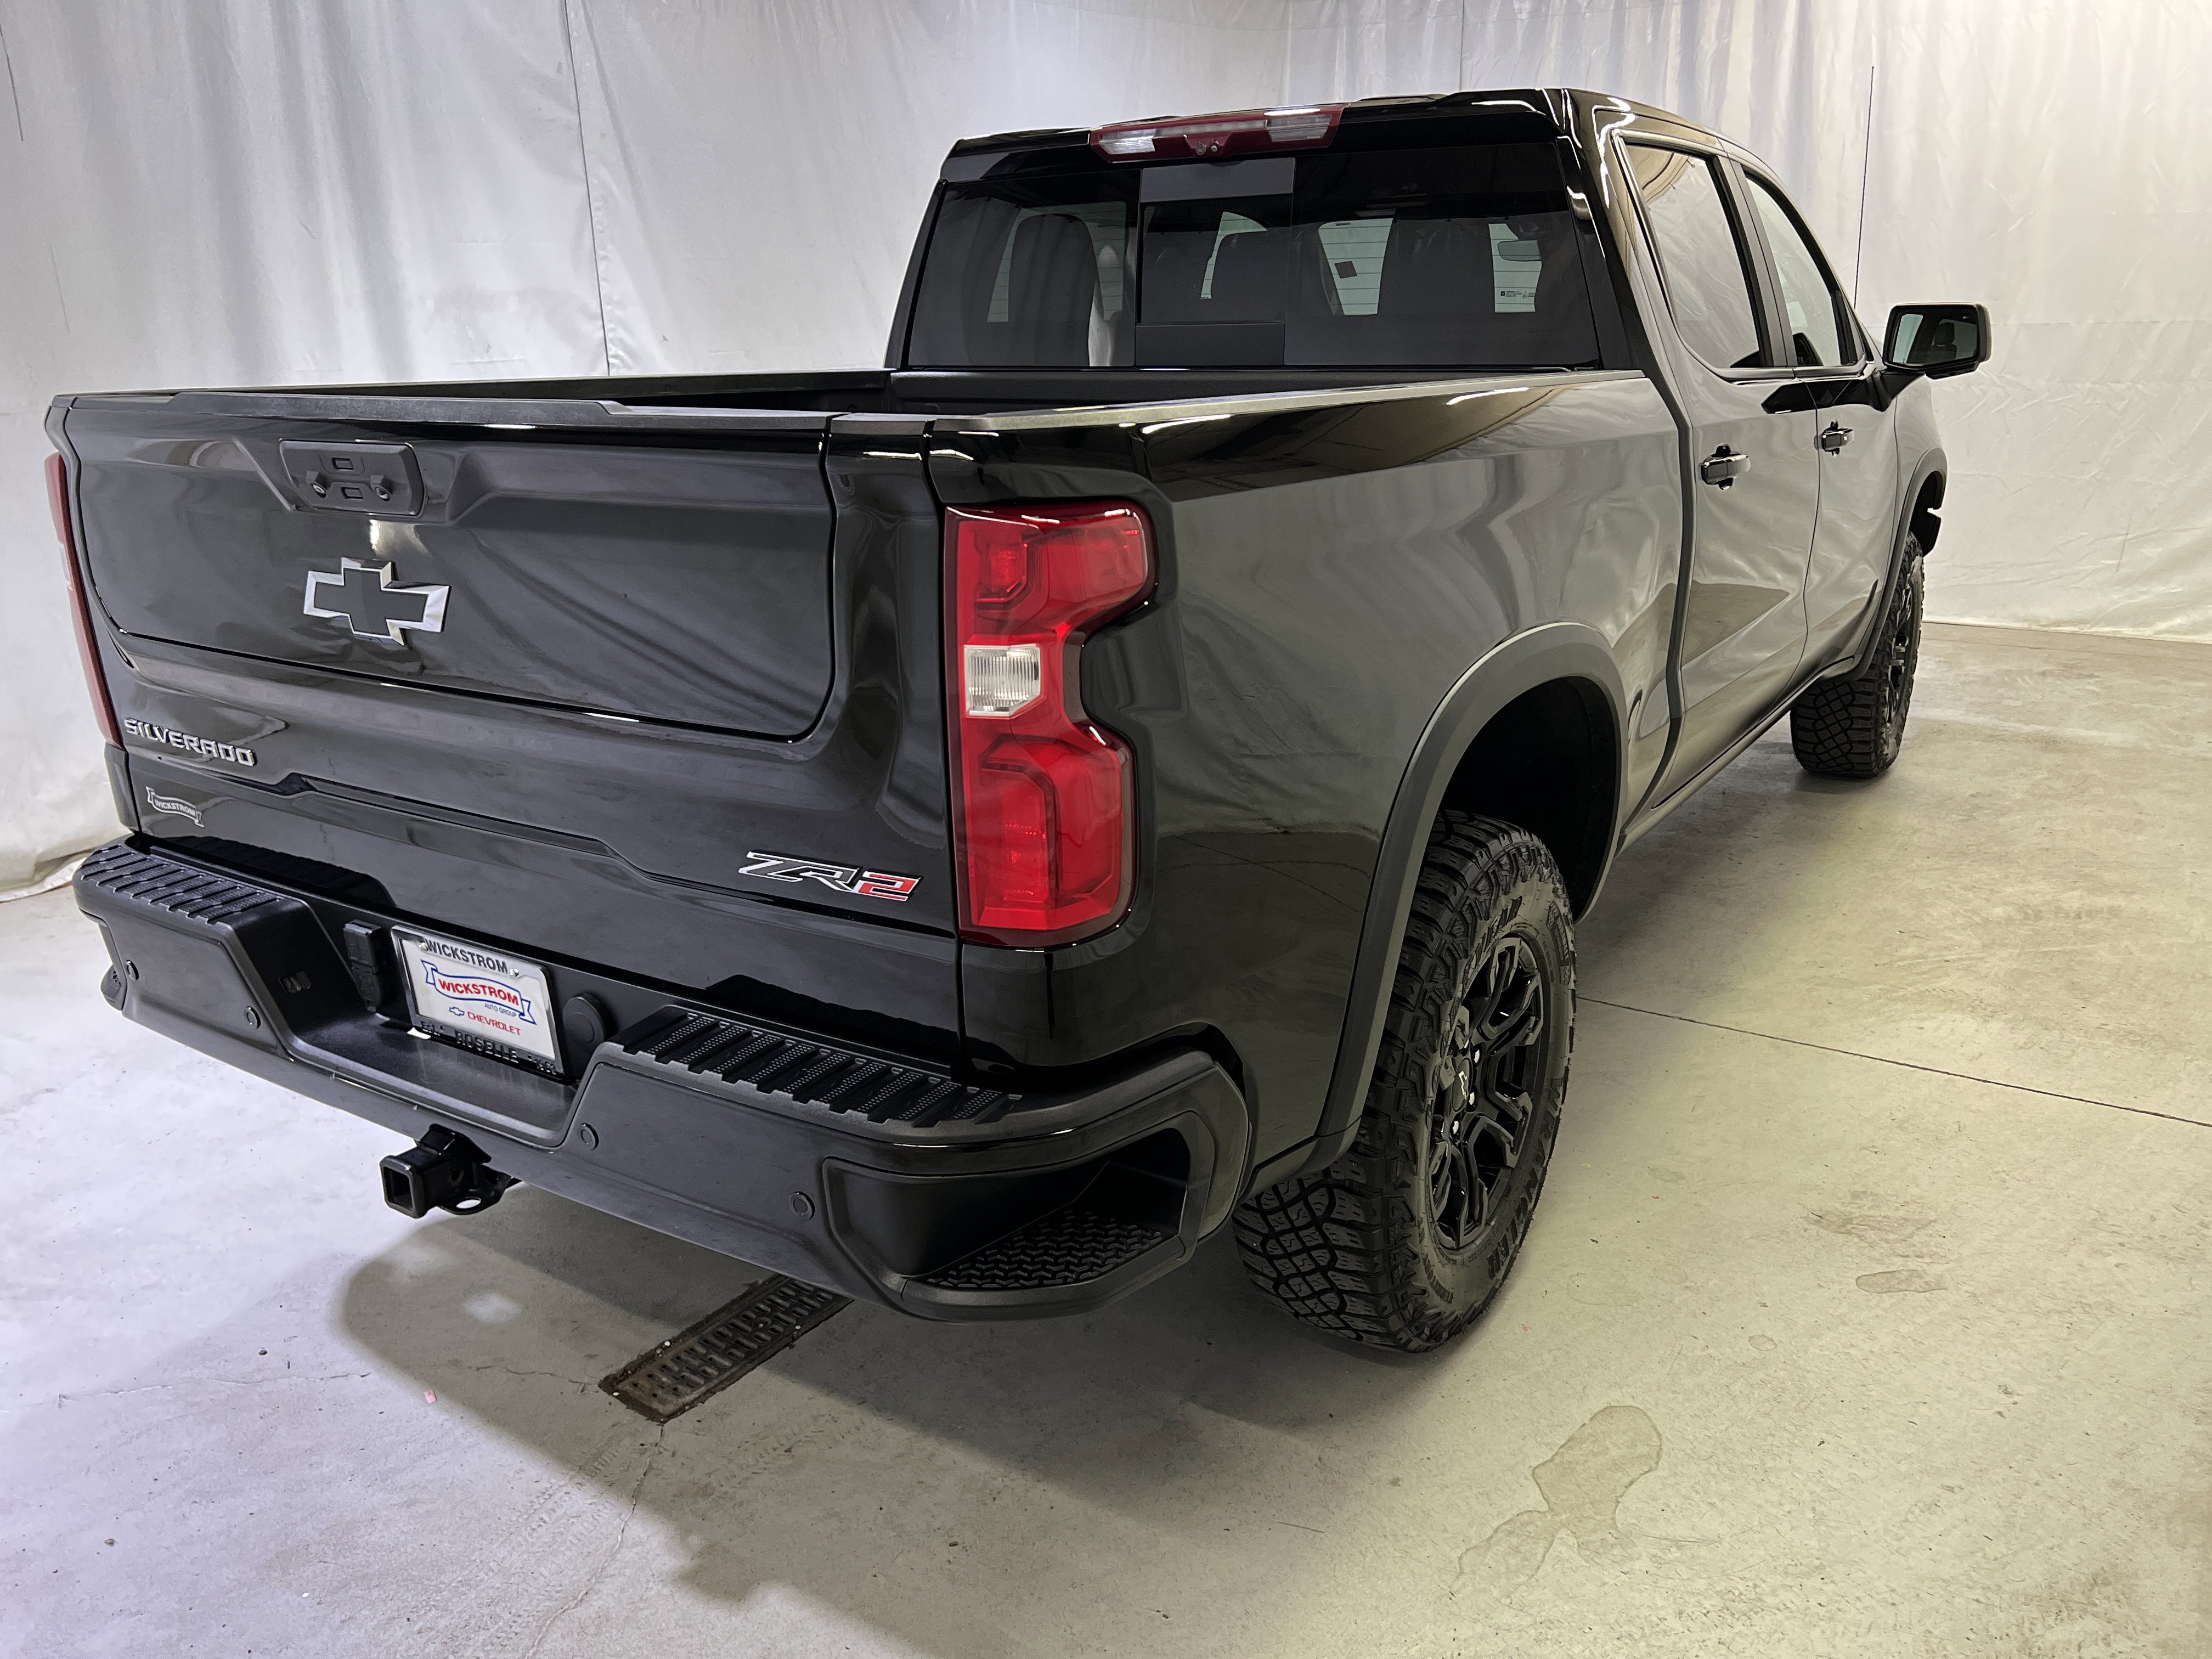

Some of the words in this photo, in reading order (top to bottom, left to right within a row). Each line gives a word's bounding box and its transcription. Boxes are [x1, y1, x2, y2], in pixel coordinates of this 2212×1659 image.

[124, 718, 257, 766] SILVERADO
[155, 798, 196, 816] WICKSTROM
[738, 850, 922, 901] ZR2
[425, 938, 509, 973] WICKSTROM
[438, 978, 519, 1006] WICKSTROM
[467, 1011, 521, 1036] CHEVROLET
[484, 1002, 498, 1013] AUTO
[499, 1007, 517, 1018] GROUP
[455, 1030, 518, 1063] ROSELLE
[1486, 1077, 1564, 1280] WRANGLER
